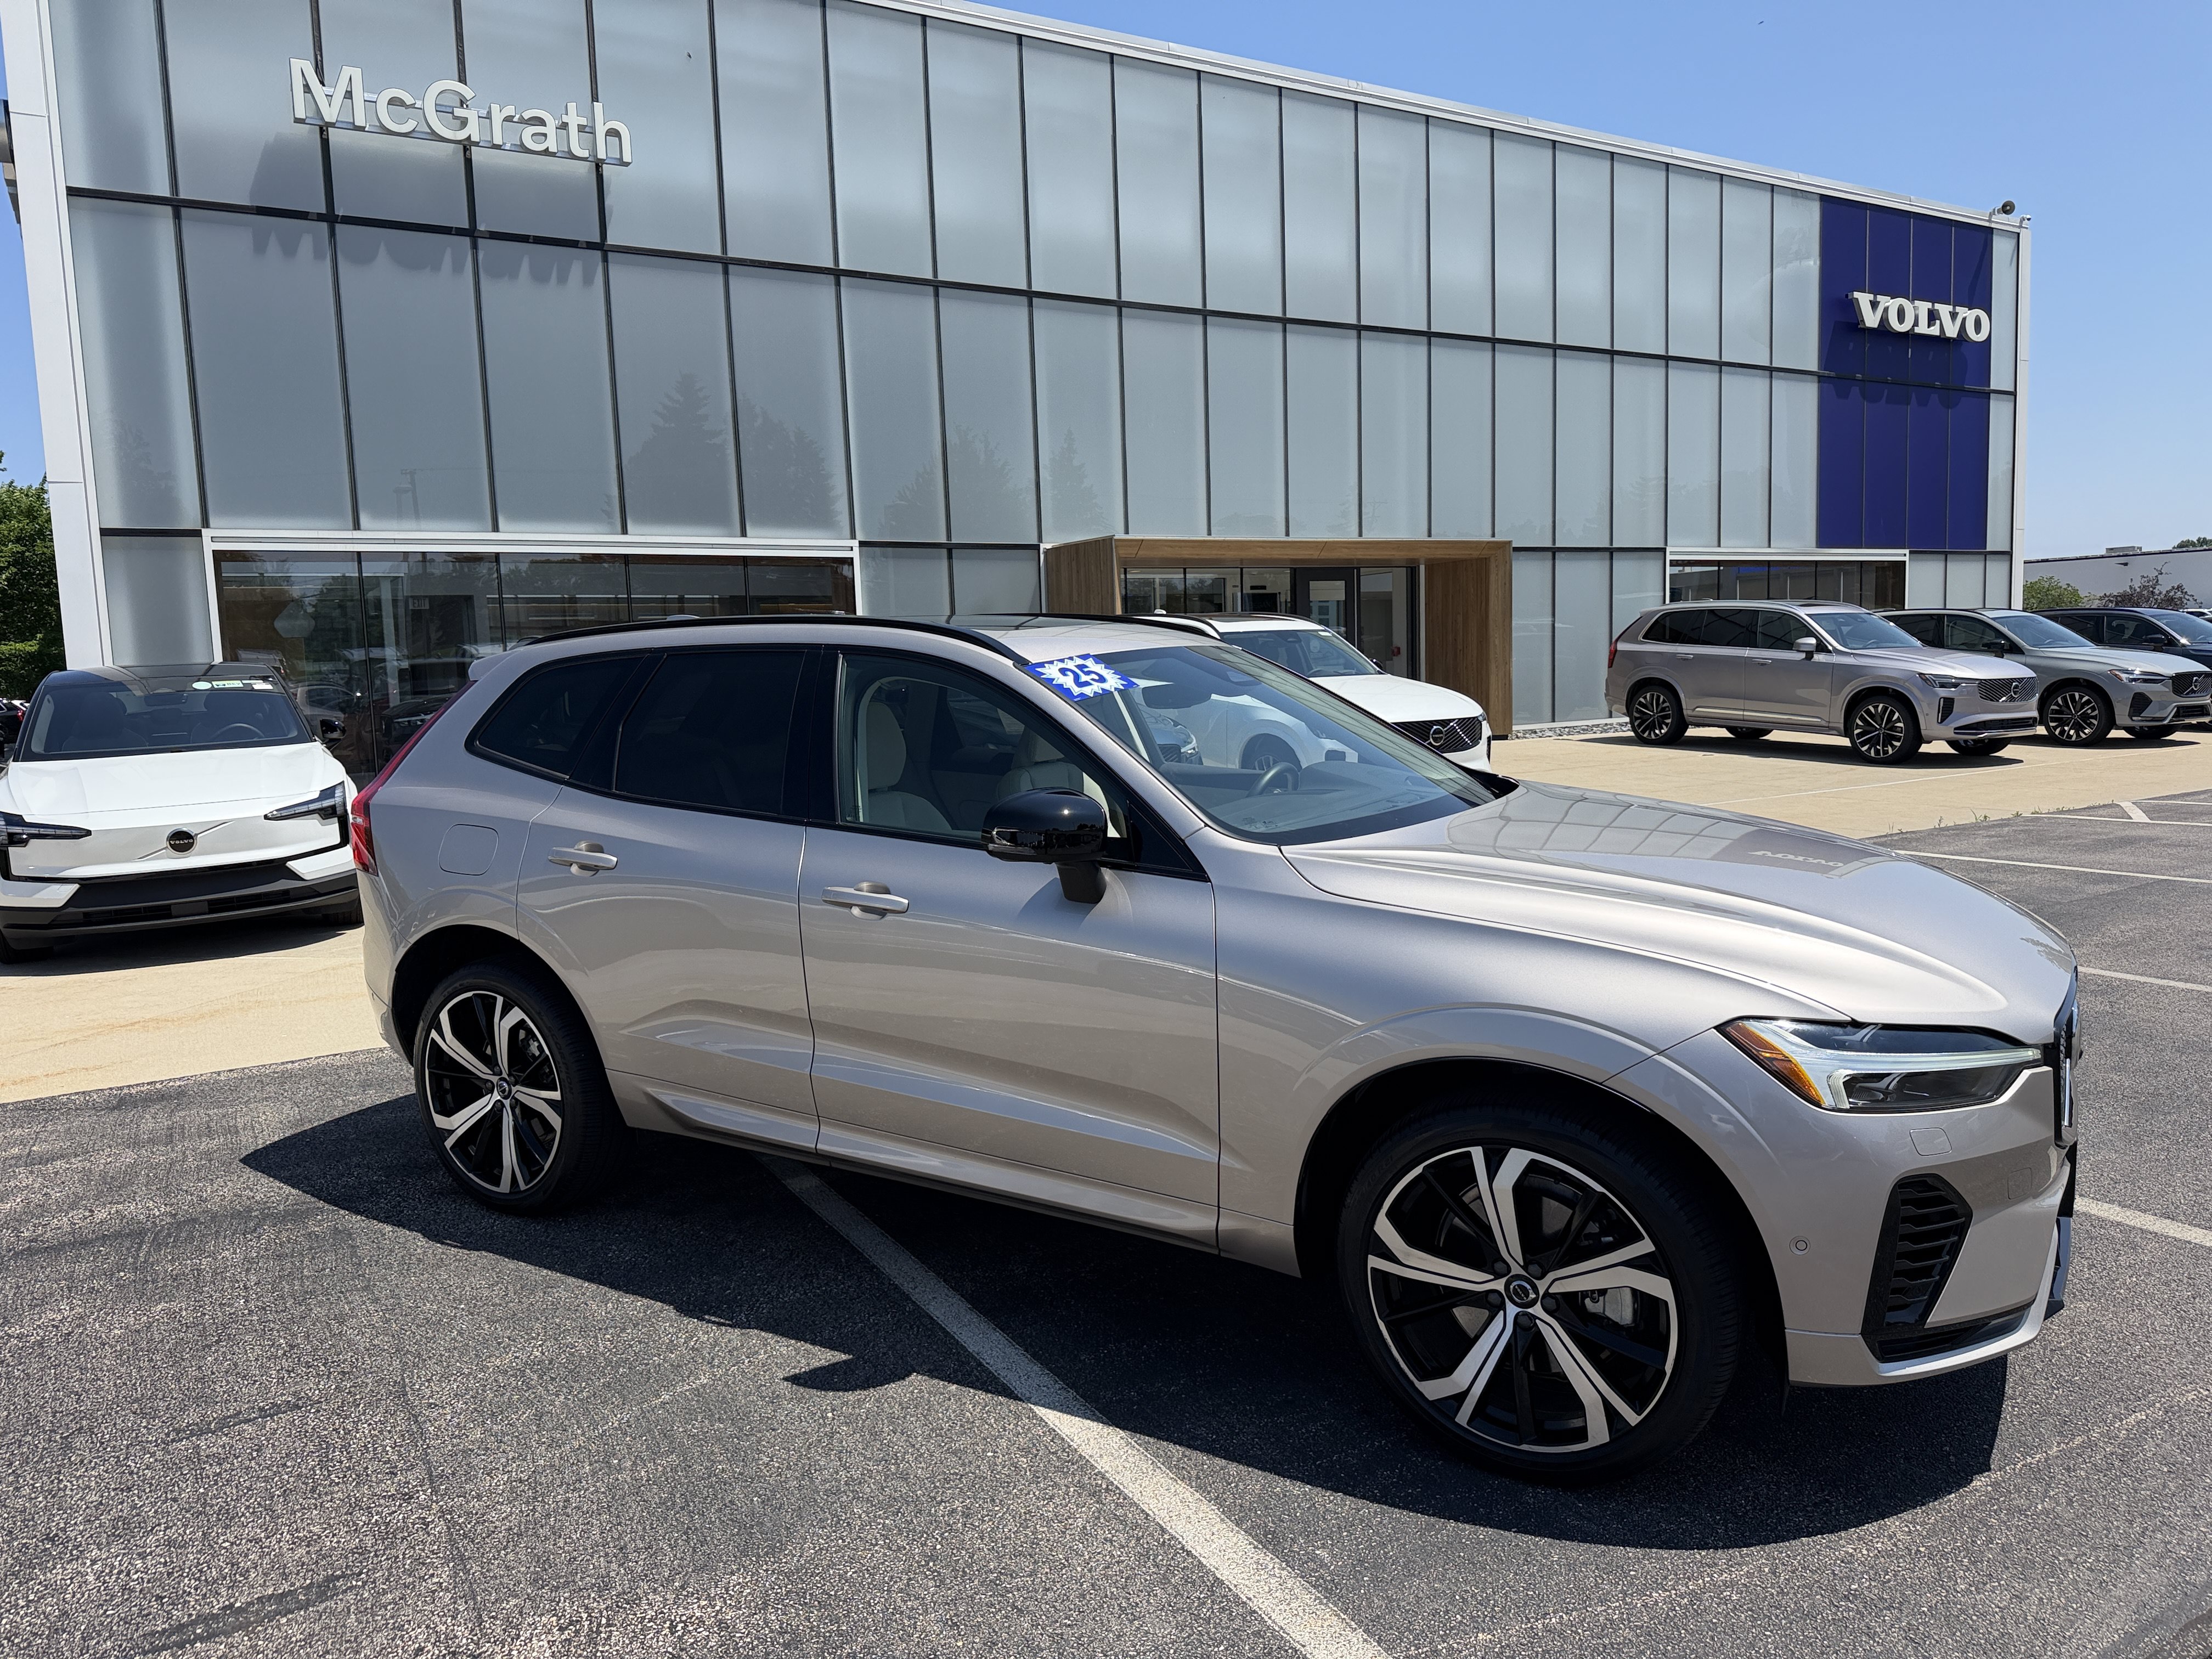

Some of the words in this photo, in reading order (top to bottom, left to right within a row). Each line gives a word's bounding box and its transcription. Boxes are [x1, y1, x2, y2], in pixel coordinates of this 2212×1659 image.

[289, 58, 633, 166] McGrath
[1853, 291, 1990, 342] VOLVO
[412, 599, 426, 608] EXIT
[1058, 664, 1109, 688] 25
[1515, 1285, 1527, 1300] VOLVO
